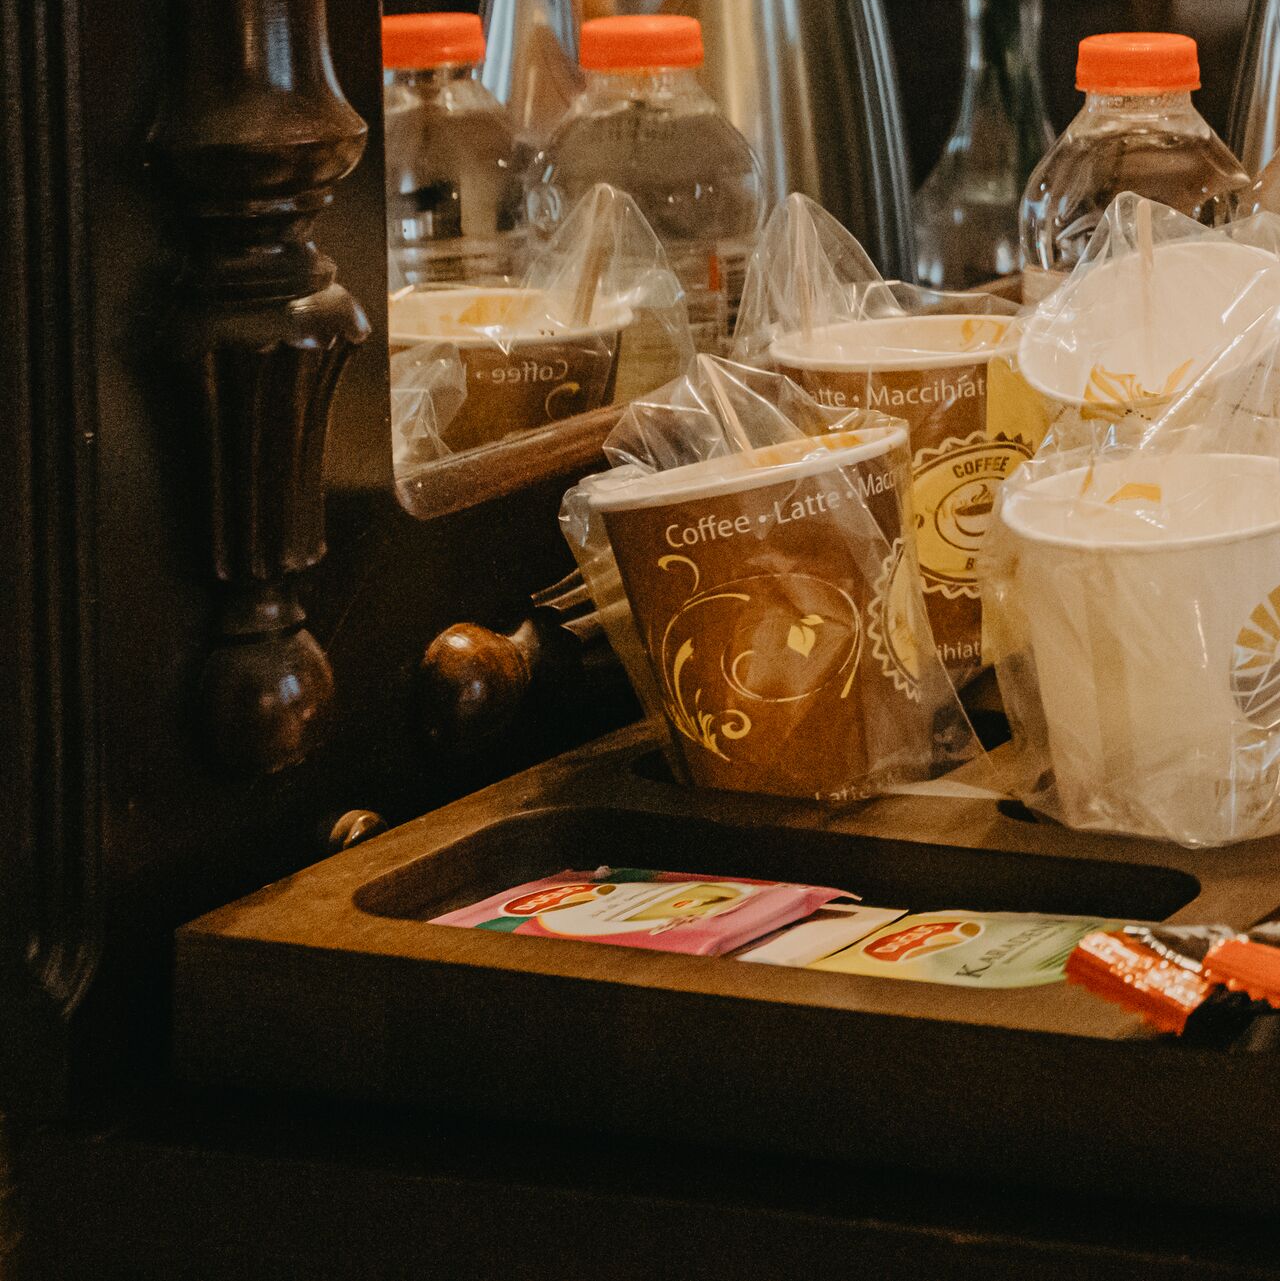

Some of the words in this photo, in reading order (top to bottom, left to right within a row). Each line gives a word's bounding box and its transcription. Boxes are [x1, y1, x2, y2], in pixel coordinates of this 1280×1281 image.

[808, 387, 847, 408] atte
[951, 456, 1010, 479] COFFEE
[665, 511, 751, 549] Coffee
[774, 486, 841, 526] Latte
